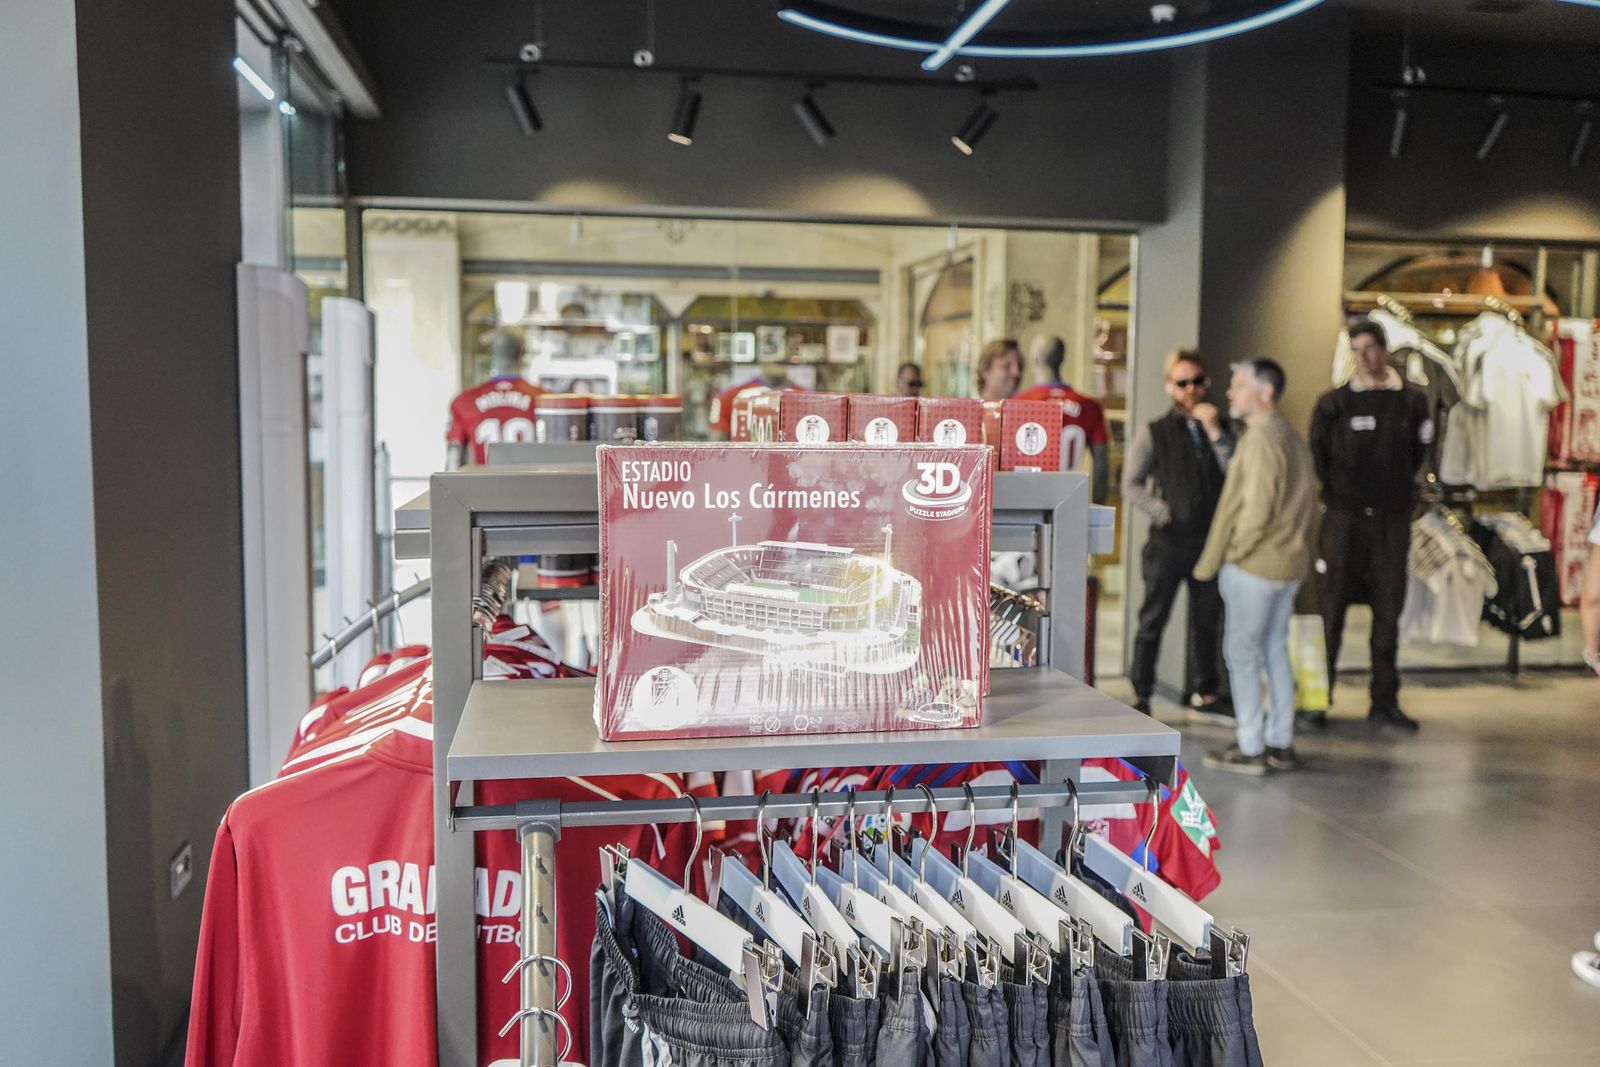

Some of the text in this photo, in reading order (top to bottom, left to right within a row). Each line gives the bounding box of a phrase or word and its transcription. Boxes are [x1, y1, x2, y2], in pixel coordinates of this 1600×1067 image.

[621, 461, 692, 482] ESTADIO
[915, 461, 961, 495] 3D
[623, 482, 861, 509] Nuevo Los Cármenes
[909, 504, 965, 518] PUZZLE STADIUM
[331, 860, 522, 918] GRAAD
[335, 914, 437, 944] CLUB DE
